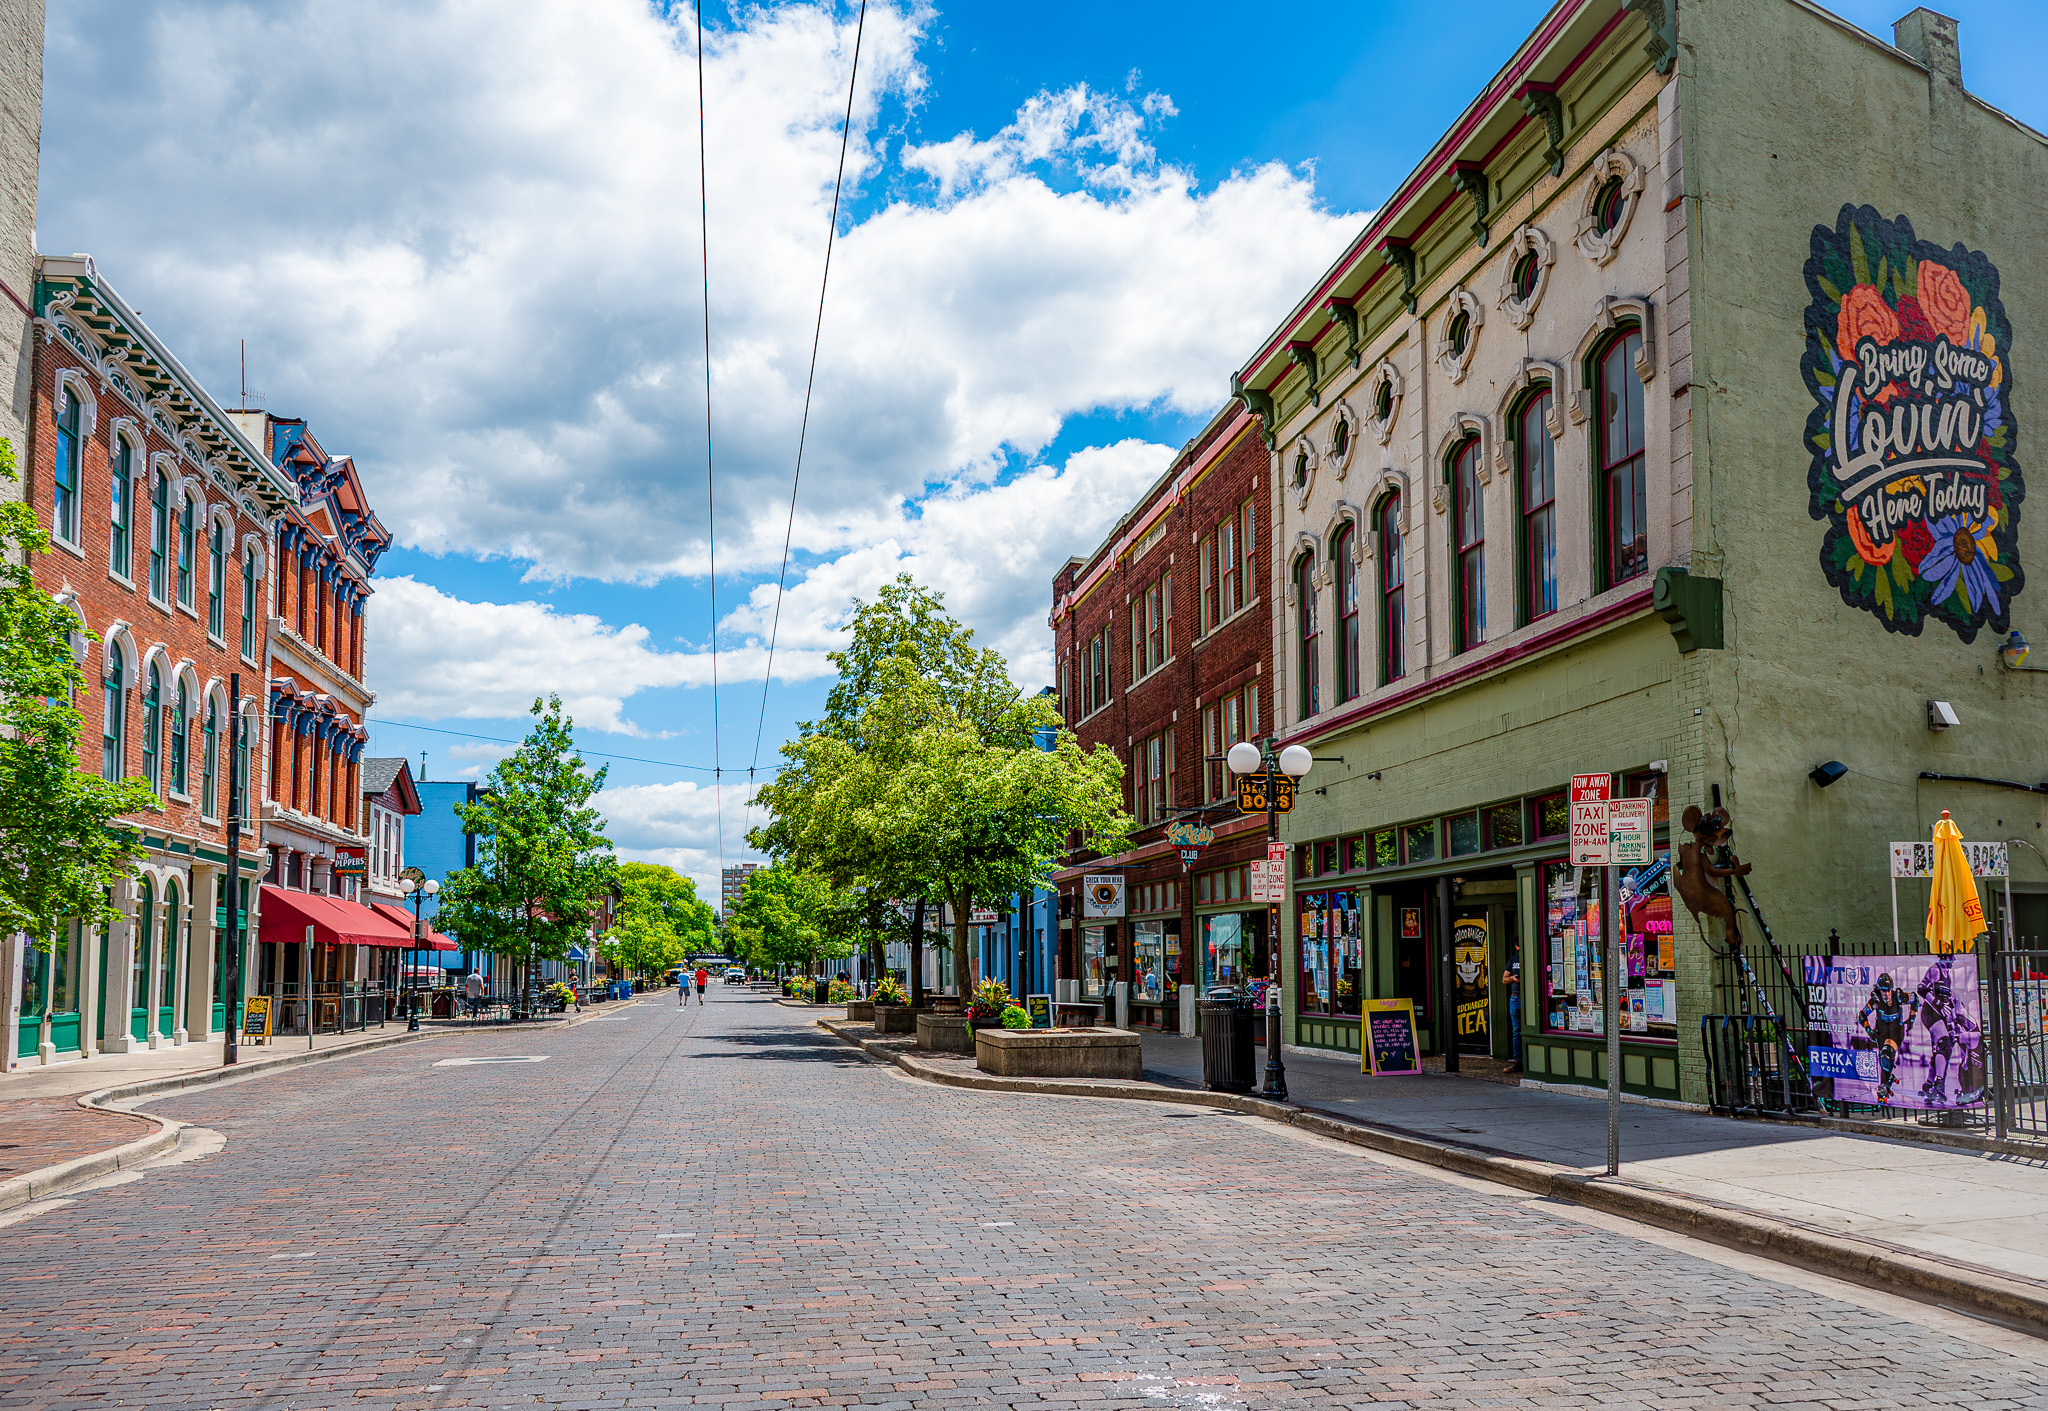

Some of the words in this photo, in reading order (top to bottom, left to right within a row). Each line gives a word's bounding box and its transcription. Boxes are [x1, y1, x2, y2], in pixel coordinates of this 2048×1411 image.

[1859, 342, 1927, 396] Bring
[1935, 340, 1989, 389] Some
[1862, 488, 1922, 540] Here
[1924, 471, 1986, 518] Today
[1573, 777, 1588, 789] TOW
[1589, 775, 1609, 788] AWAY
[1580, 789, 1601, 801] ZONE
[1609, 802, 1620, 811] NO
[1622, 802, 1646, 810] PARKING
[1577, 807, 1604, 820] TAXI
[1164, 821, 1193, 844] Gem
[1187, 826, 1214, 846] City
[1573, 822, 1608, 836] ZONE
[1573, 838, 1608, 846] 8PM-4AM
[1613, 833, 1620, 841] 2
[336, 852, 349, 860] NED
[1181, 850, 1198, 859] CLUB
[335, 857, 365, 868] PEPPERS
[1251, 862, 1259, 871] NO
[1271, 864, 1283, 872] TAXI
[1647, 861, 1664, 876] LIGHT
[1269, 875, 1284, 883] ZONE
[1645, 920, 1673, 934] open
[1808, 985, 1847, 1004] HOME
[1829, 1006, 1860, 1022] CITY
[1457, 1009, 1488, 1036] TEA
[1832, 1023, 1858, 1034] DERBY
[1810, 1050, 1853, 1067] REYKA
[1821, 1065, 1846, 1074] VODKA
